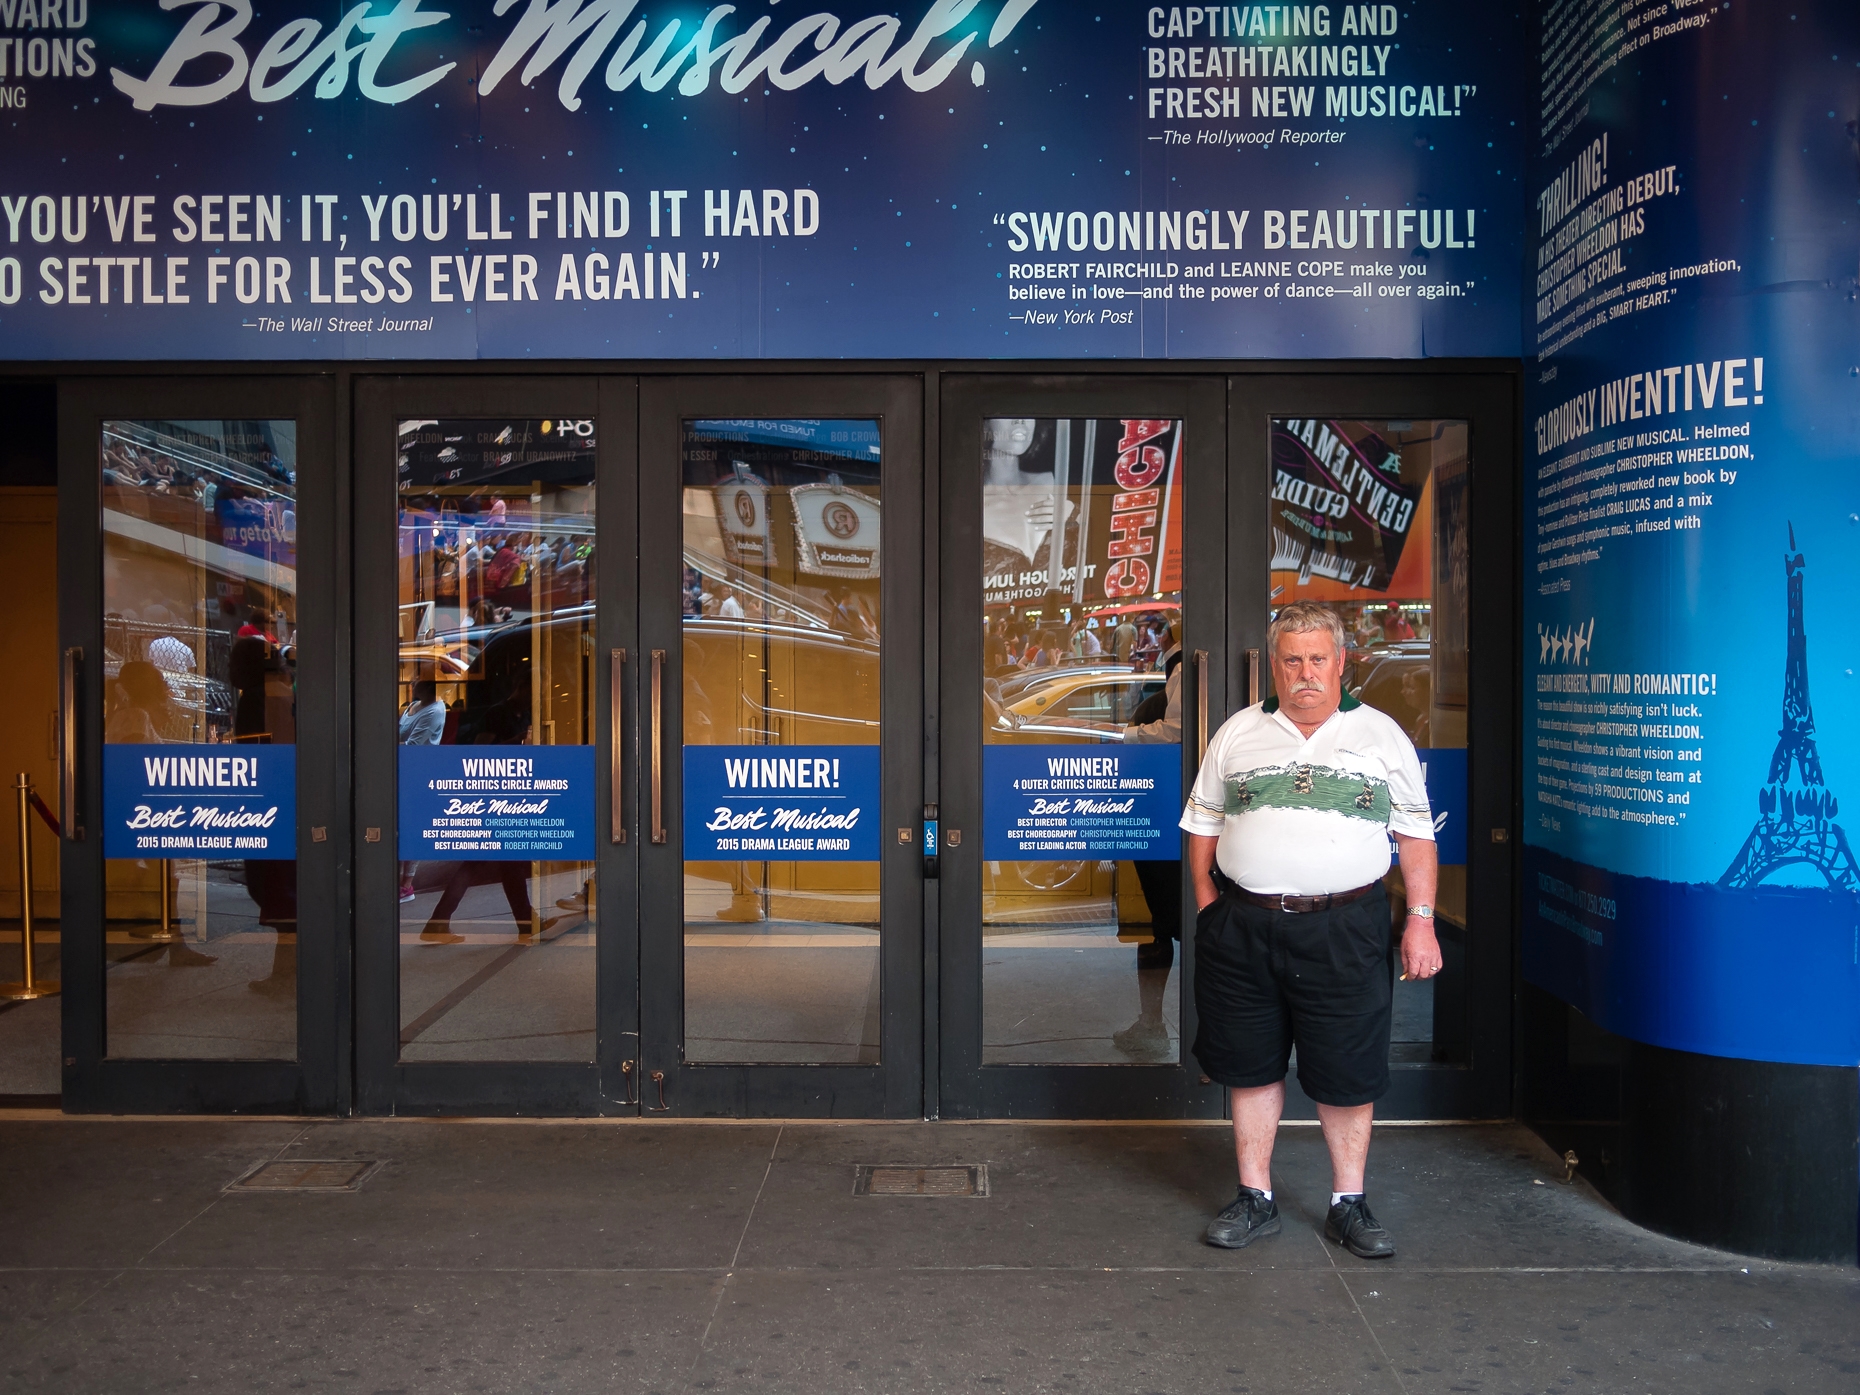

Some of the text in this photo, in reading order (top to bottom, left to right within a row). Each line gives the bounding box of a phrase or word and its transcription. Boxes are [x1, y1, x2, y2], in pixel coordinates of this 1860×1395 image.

[1148, 5, 1398, 39] CAPTIVATING AND
[109, 0, 1038, 112] Best Musical!
[1148, 45, 1391, 79] BREATHTAKINGLY
[1148, 87, 1240, 119] FRESH
[1251, 86, 1315, 118] NEW
[1196, 130, 1275, 148] Hollywood
[1280, 129, 1347, 147] Reporter
[1581, 165, 1680, 235] DIRECTING DEBUT,
[172, 195, 281, 243] SEEN
[302, 195, 347, 251] IT,
[361, 194, 513, 242] YOU’LL
[528, 192, 630, 240] FIND
[649, 190, 688, 238] IT
[704, 189, 820, 237] HARD
[1264, 209, 1475, 250] BEAUTIFUL!
[1576, 207, 1645, 267] WHEELDON HAS
[39, 257, 190, 305] SETTLE
[207, 257, 292, 304] FOR
[310, 256, 413, 303] LESS
[430, 255, 540, 302] EVER
[1010, 261, 1427, 280] ROBERT FAIRCHILD and LEANNE COPE make you
[1626, 258, 1742, 292] sweeping innovation,
[1010, 284, 1066, 300] believe
[1072, 284, 1087, 299] in
[1178, 283, 1205, 299] the
[1211, 285, 1259, 301] power
[1264, 282, 1280, 298] of
[1377, 285, 1411, 297] over
[1064, 309, 1095, 324] York
[1101, 309, 1134, 324] Post
[1608, 299, 1634, 320] SMART
[291, 317, 323, 332] Wall
[327, 317, 374, 332] Street
[378, 316, 434, 332] Journal
[1600, 357, 1764, 428] INVENTIVE!
[1617, 421, 1750, 451] NEW MUSICAL. Helmed
[1616, 444, 1755, 472] CHRISTOPHER WHEELDON,
[1657, 468, 1738, 489] new book by
[1625, 493, 1713, 513] LUCAS mix
[1611, 514, 1701, 536] music, infused with
[1634, 673, 1717, 695] ROMANTIC!
[1671, 703, 1703, 718] luck.
[1596, 722, 1704, 740] CHRISTOPHER WHEELDON.
[1643, 746, 1674, 760] vision
[144, 757, 257, 787] WINNER!
[462, 758, 533, 778] WINNER!
[724, 758, 840, 788] WINNER!
[1047, 757, 1119, 777] WINNER!
[1624, 765, 1684, 783] design team
[428, 779, 569, 790] 4 OUTER CRITICS CIRCLE AWARDS
[1013, 778, 1155, 790] 4 OUTER CRITICS CIRCLE AWARDS
[1603, 784, 1664, 803] PRODUCTIONS
[443, 798, 549, 816] Best Musical
[1028, 797, 1135, 815] Best Musical
[125, 805, 278, 831] Best Musical
[432, 818, 565, 827] BEST DIRECTOR CHRISTOPHER WHEELDON
[705, 806, 861, 832] Best Musical
[1017, 817, 1151, 827] BEST DIRECTOR CHRISTOPHER WHEELDON
[136, 836, 268, 849] 2015 DRAMA LEAGUE AWARD
[423, 830, 575, 839] BEST CHOREOGRAPHY CHRISTOPHER WHEELDON
[1007, 829, 1160, 839] BEST CHOREOGRAPHY CHRISTOPHER WHEELDON
[434, 841, 563, 850] BEST LEADING ACTOR ROBERT FAIRCHILD
[716, 838, 850, 851] 2015 DRAMA LEAGUE AWARD
[1019, 841, 1149, 850] BEST LEADING ACTOR ROBERT FAIRCHILD
